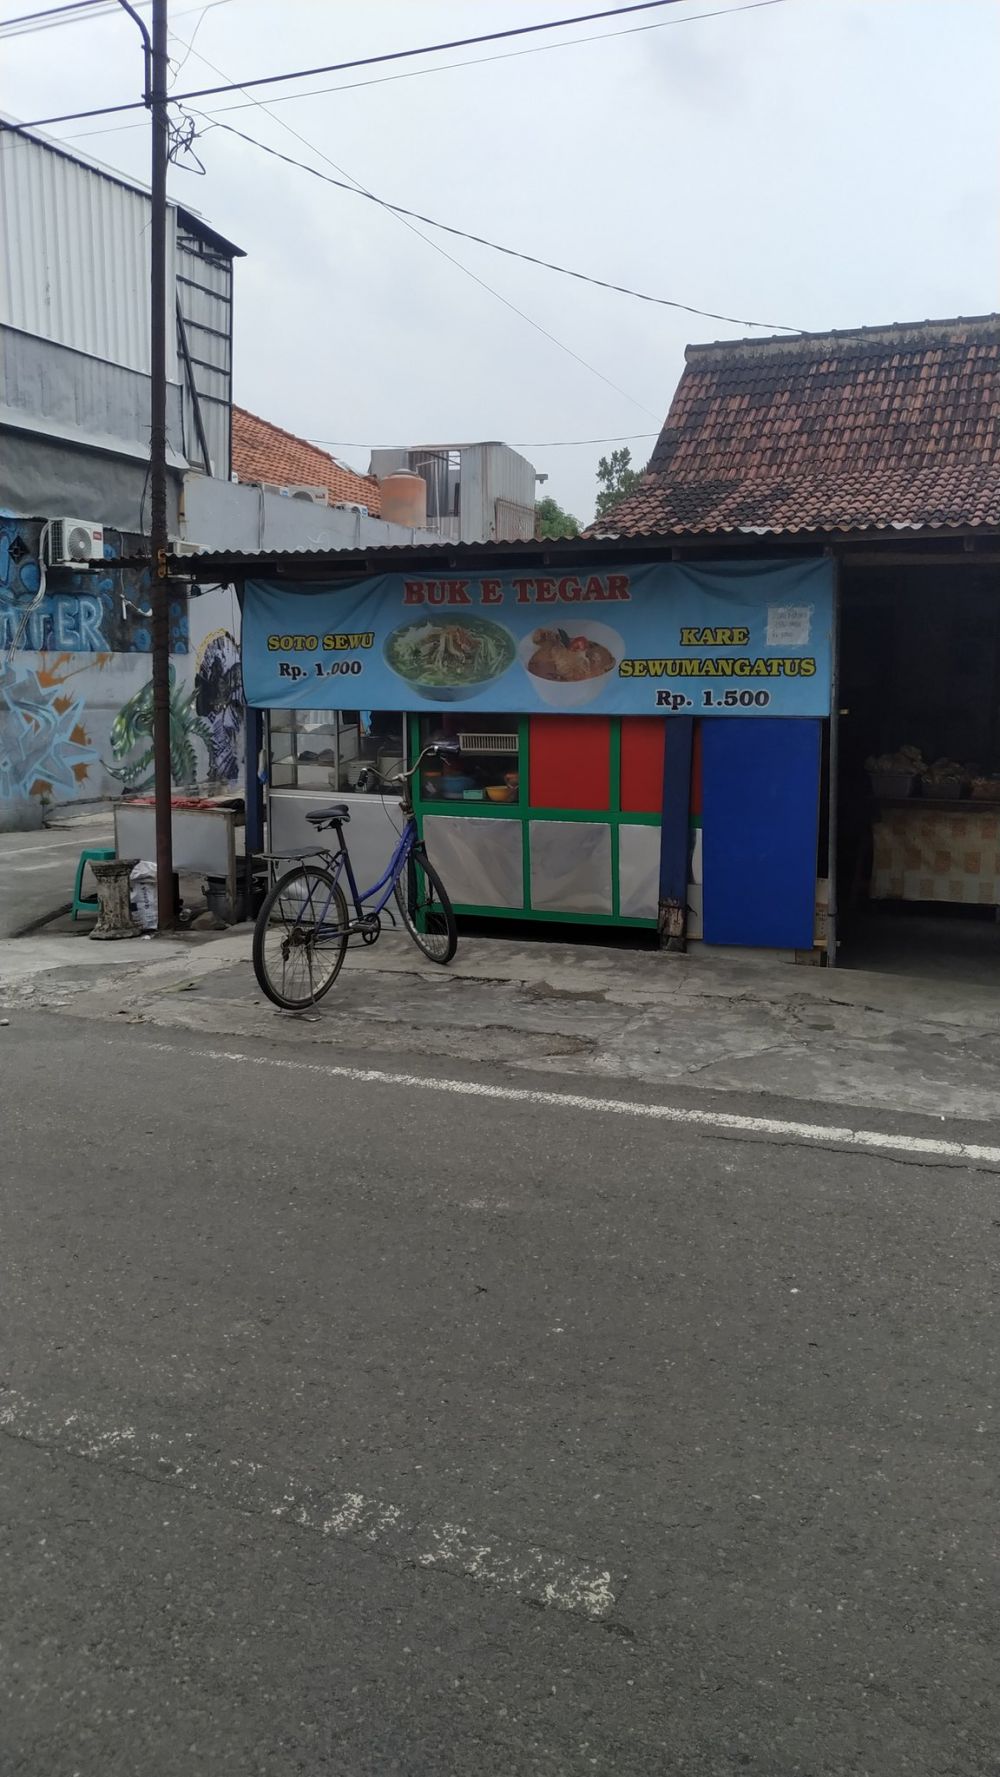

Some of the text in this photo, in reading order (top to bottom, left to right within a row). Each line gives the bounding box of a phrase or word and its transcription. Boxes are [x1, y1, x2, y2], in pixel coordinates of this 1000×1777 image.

[403, 575, 630, 606] BUK E TEGAR
[268, 632, 375, 651] SOTO SEWU
[680, 627, 749, 646] KARE
[279, 661, 362, 680] Rp. 1.000
[619, 658, 816, 678] SEWUMANGATUS
[656, 690, 770, 710] Rp. 1.500
